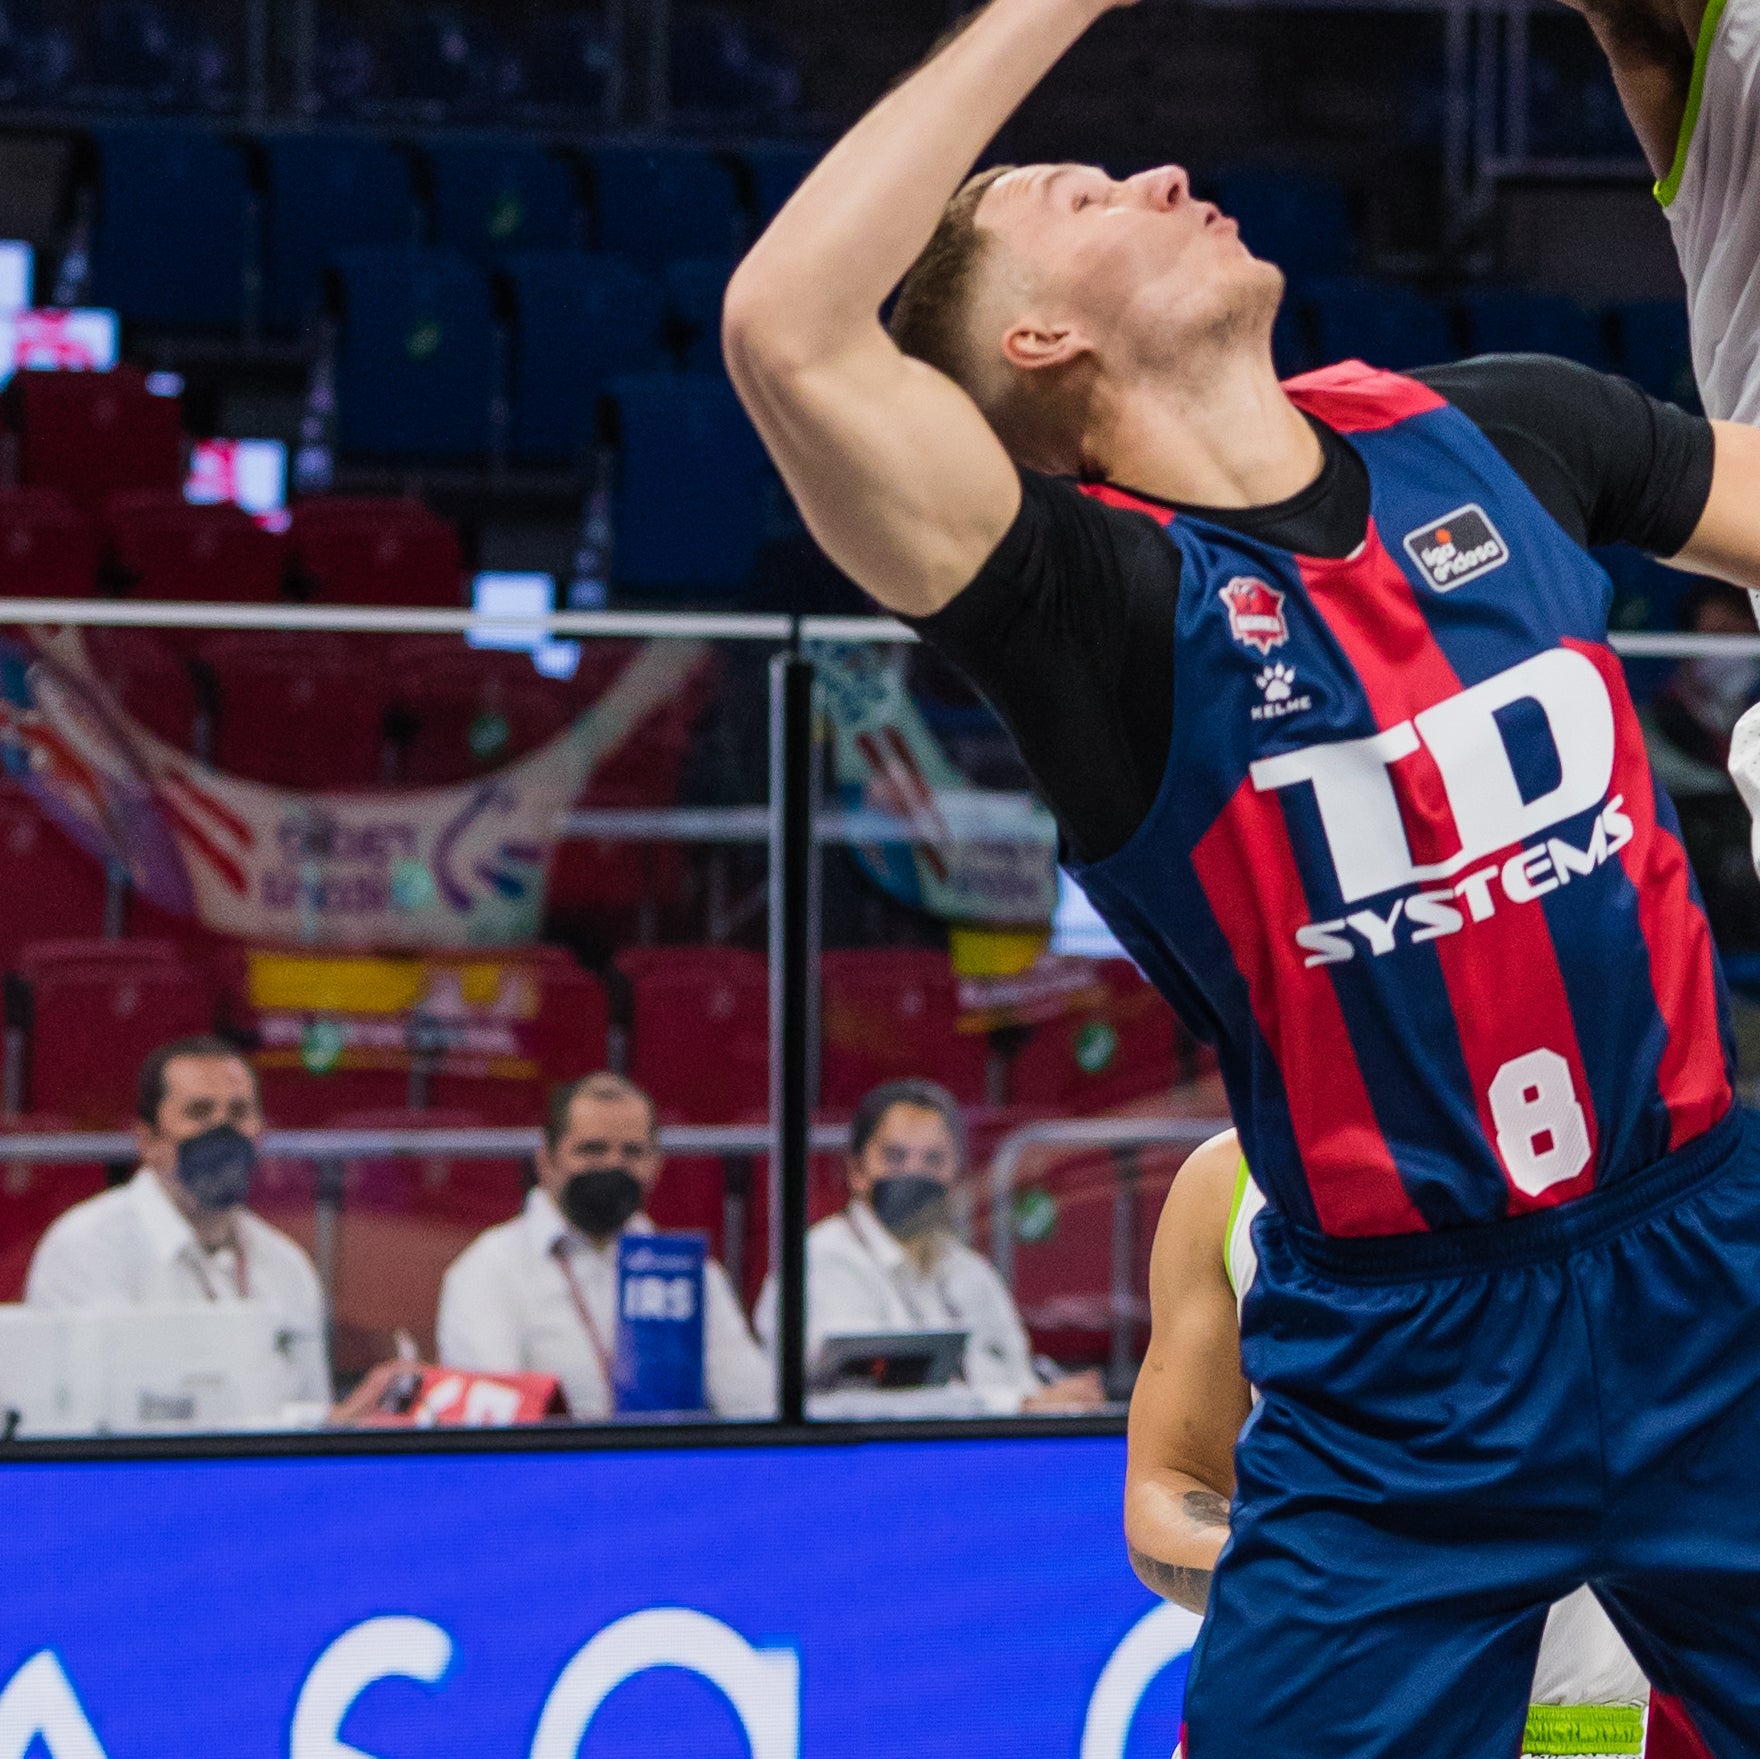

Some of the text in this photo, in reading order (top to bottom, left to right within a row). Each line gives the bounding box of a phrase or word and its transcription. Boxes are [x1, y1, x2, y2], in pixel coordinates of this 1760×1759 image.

[1249, 647, 1616, 904] TD
[1250, 694, 1312, 721] KELME
[1295, 793, 1634, 969] SYSTEMS
[1487, 1046, 1593, 1197] 8
